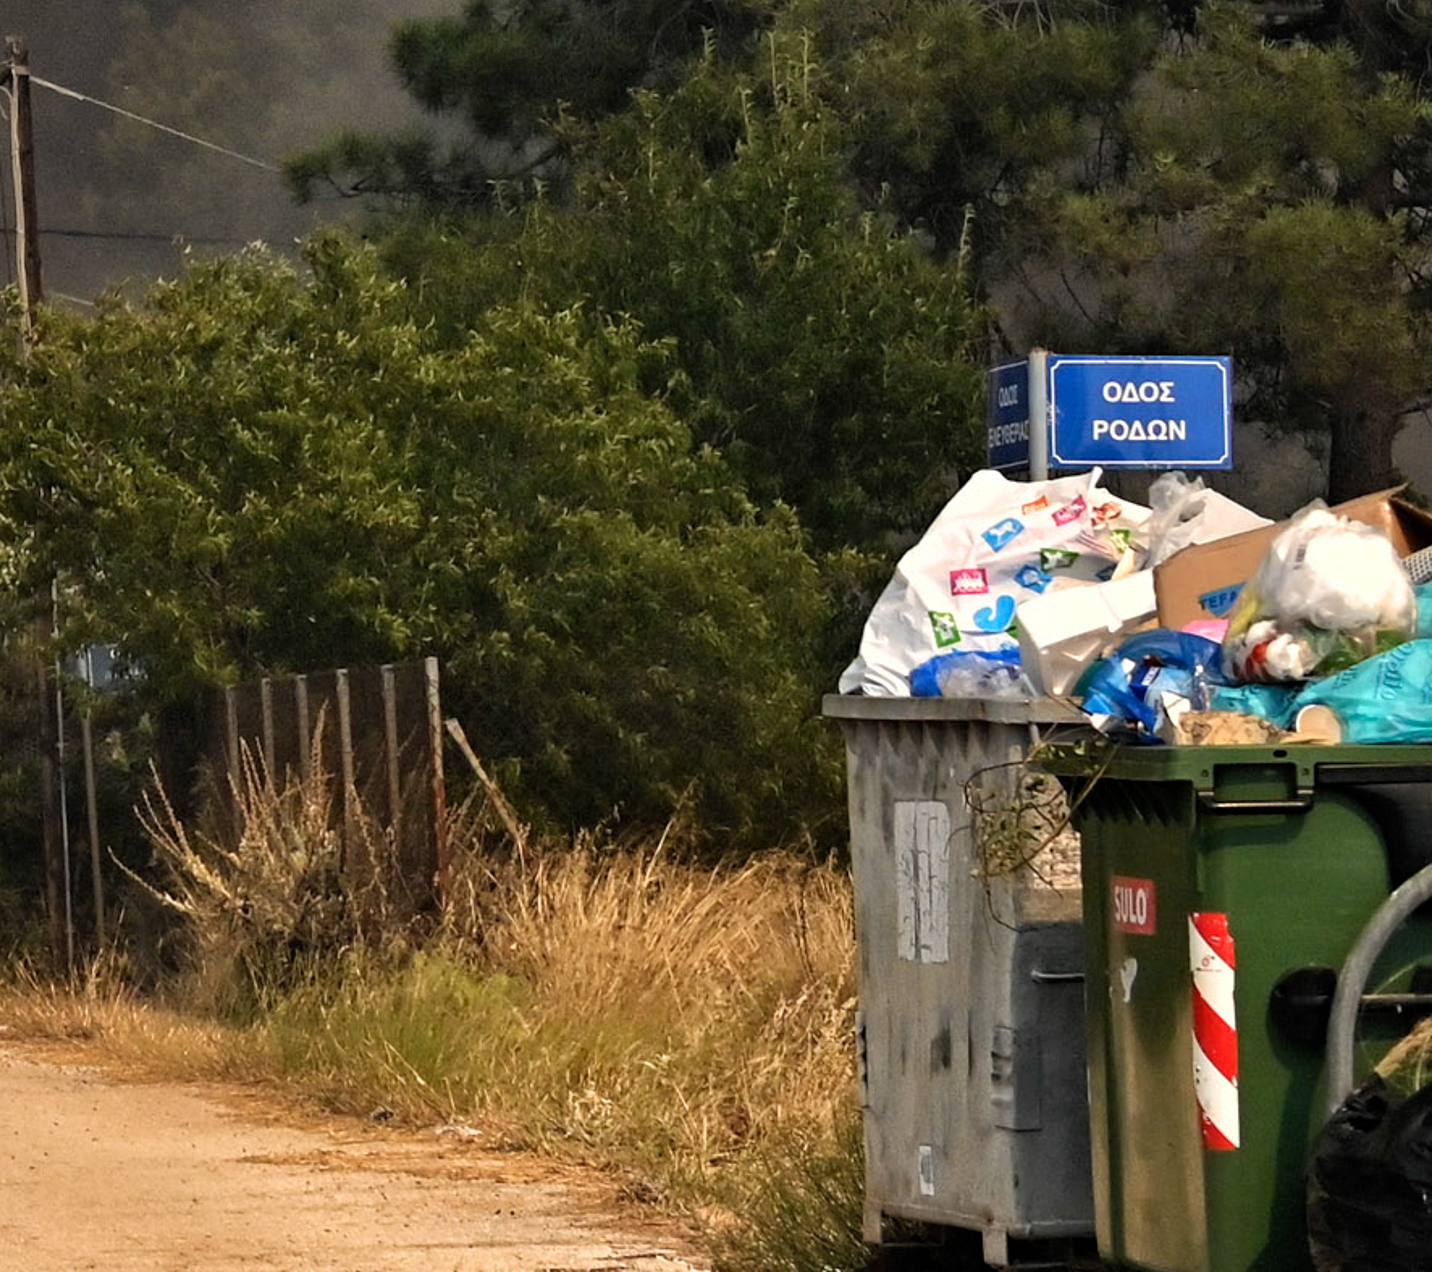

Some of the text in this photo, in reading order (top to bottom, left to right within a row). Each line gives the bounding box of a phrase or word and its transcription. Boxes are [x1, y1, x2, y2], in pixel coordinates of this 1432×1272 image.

[1102, 381, 1176, 403] ΟΔΟΣ
[1092, 419, 1187, 441] ΡΟΔΩΝ
[1114, 885, 1148, 926] SULO
